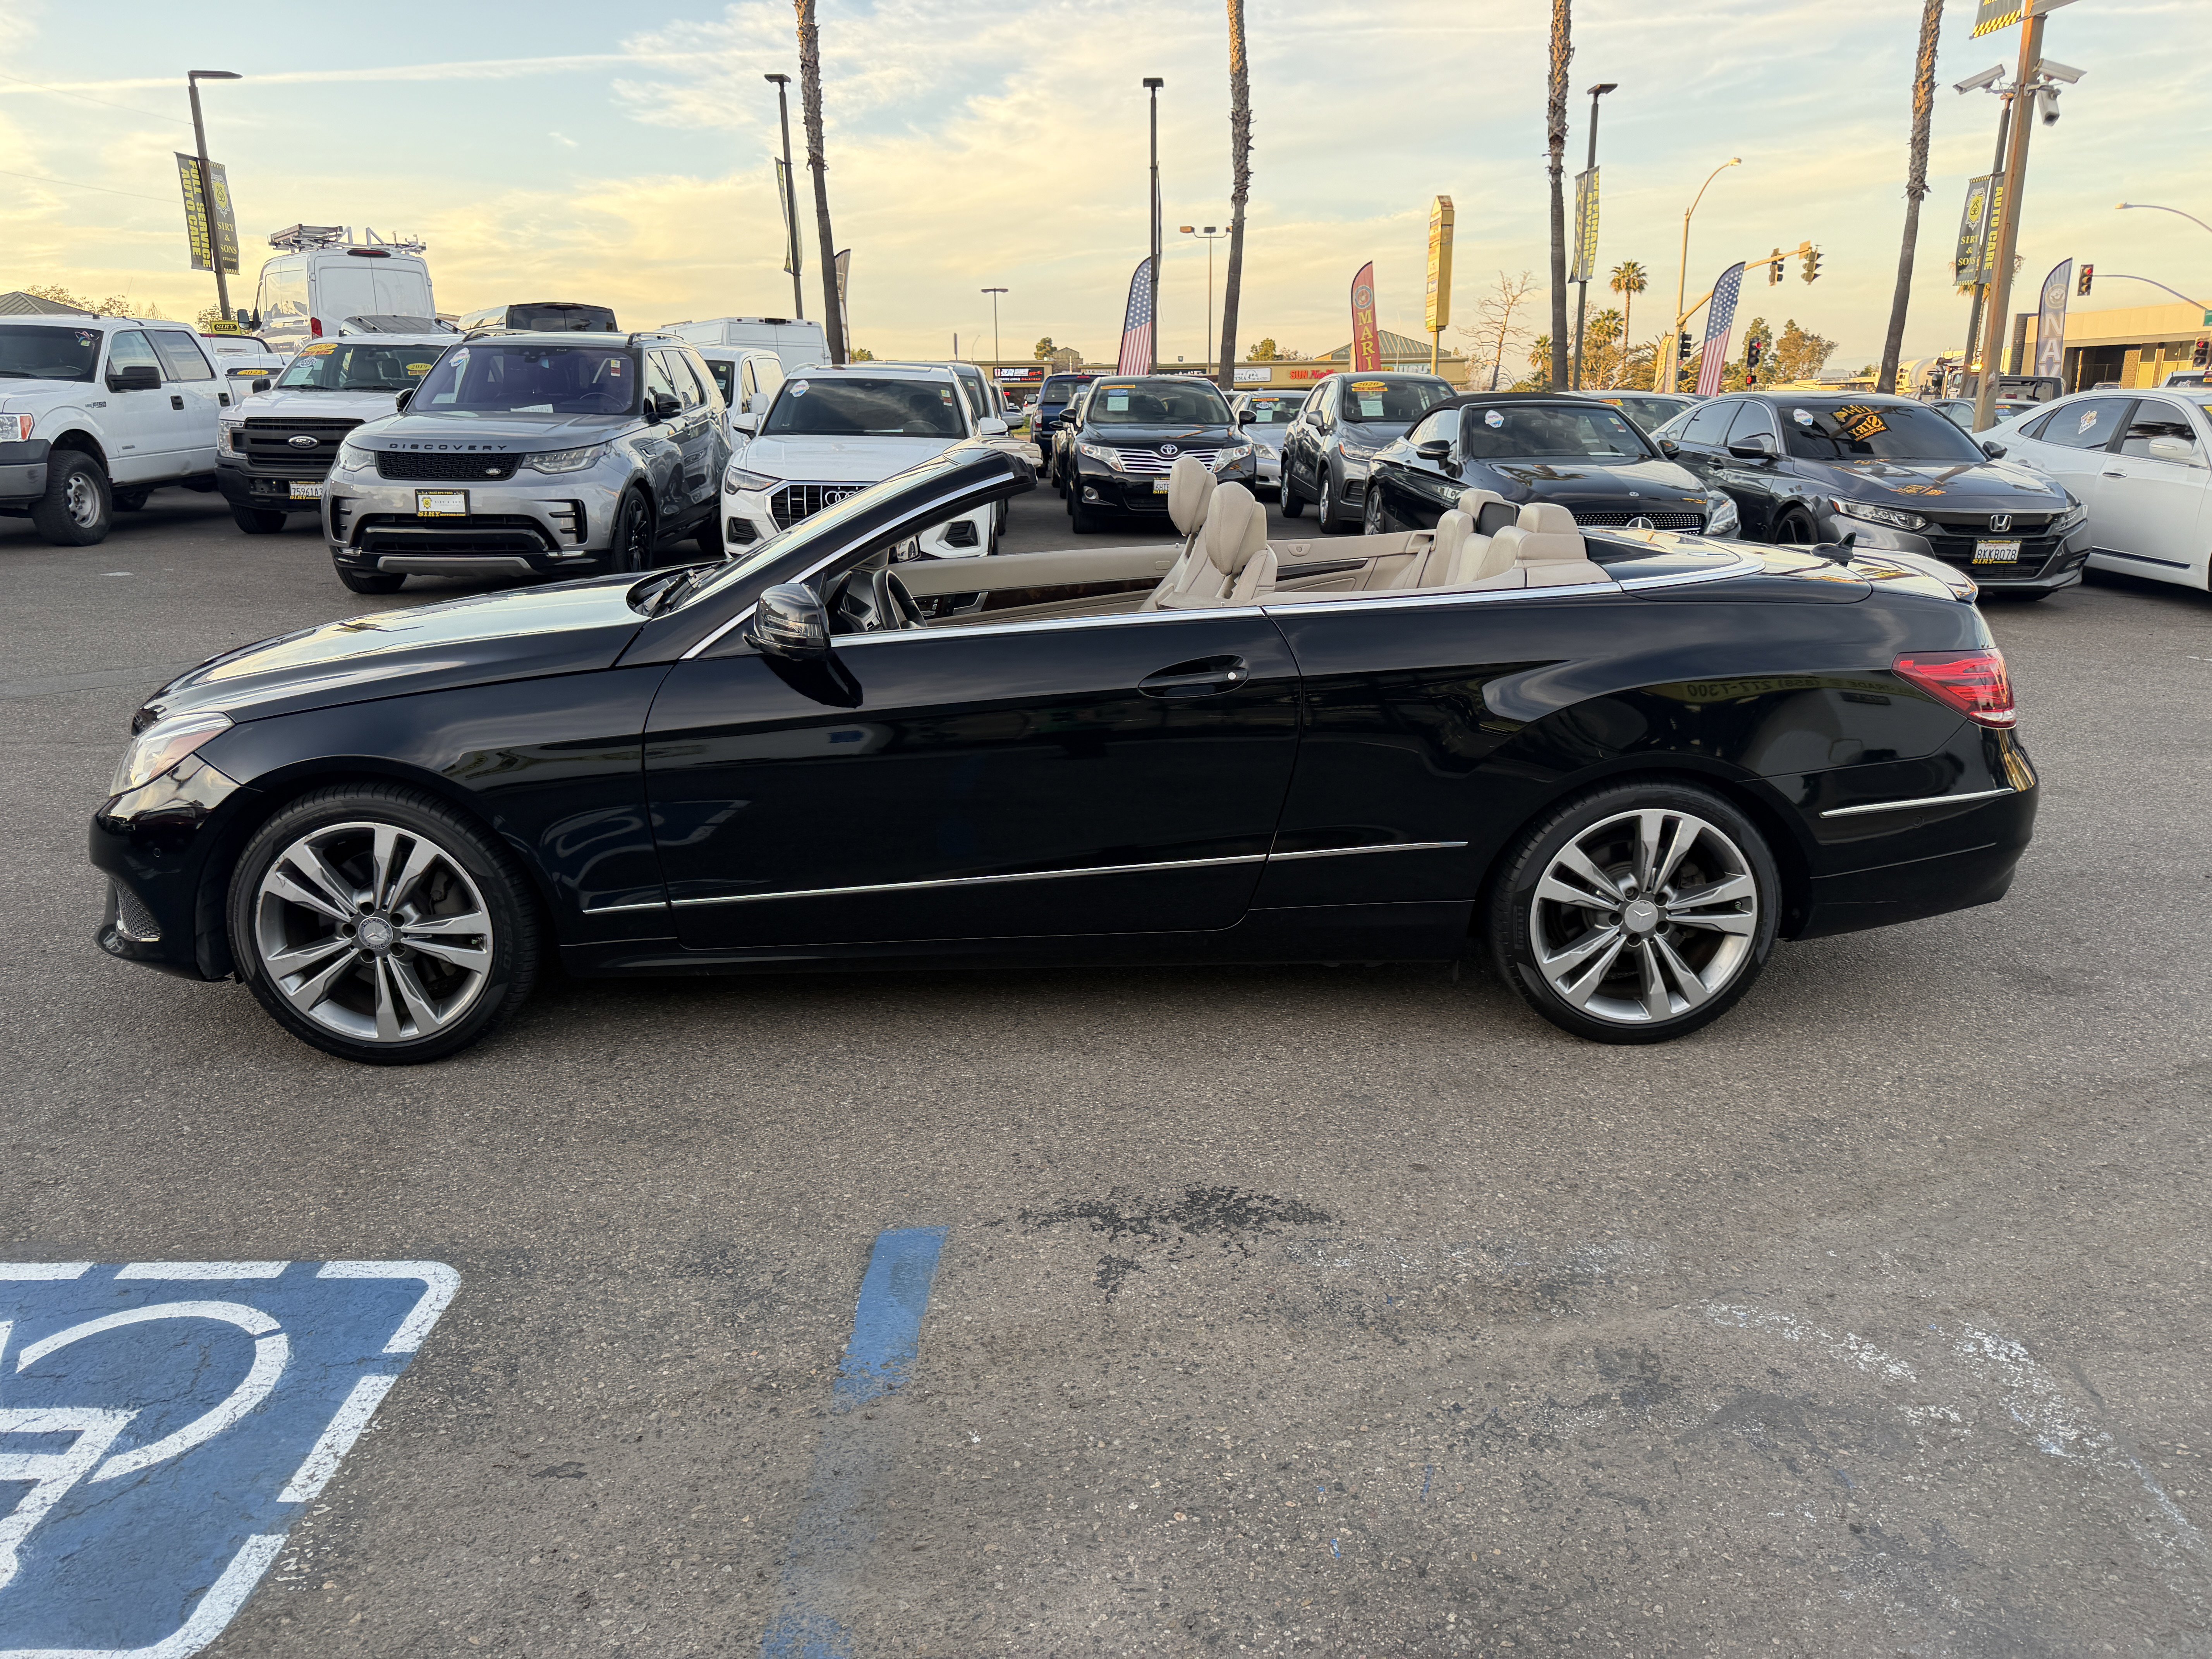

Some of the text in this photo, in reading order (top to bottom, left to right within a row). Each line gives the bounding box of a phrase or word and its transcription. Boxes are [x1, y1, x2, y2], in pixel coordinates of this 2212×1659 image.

[181, 167, 201, 256] AUTO CARE
[189, 159, 211, 268] FULL SERVICE
[217, 222, 234, 232] SIRY
[1984, 186, 2003, 270] AUTO CARE
[220, 244, 237, 254] SONS
[1290, 370, 1308, 380] SUN
[1976, 549, 2017, 560] 8KKB078
